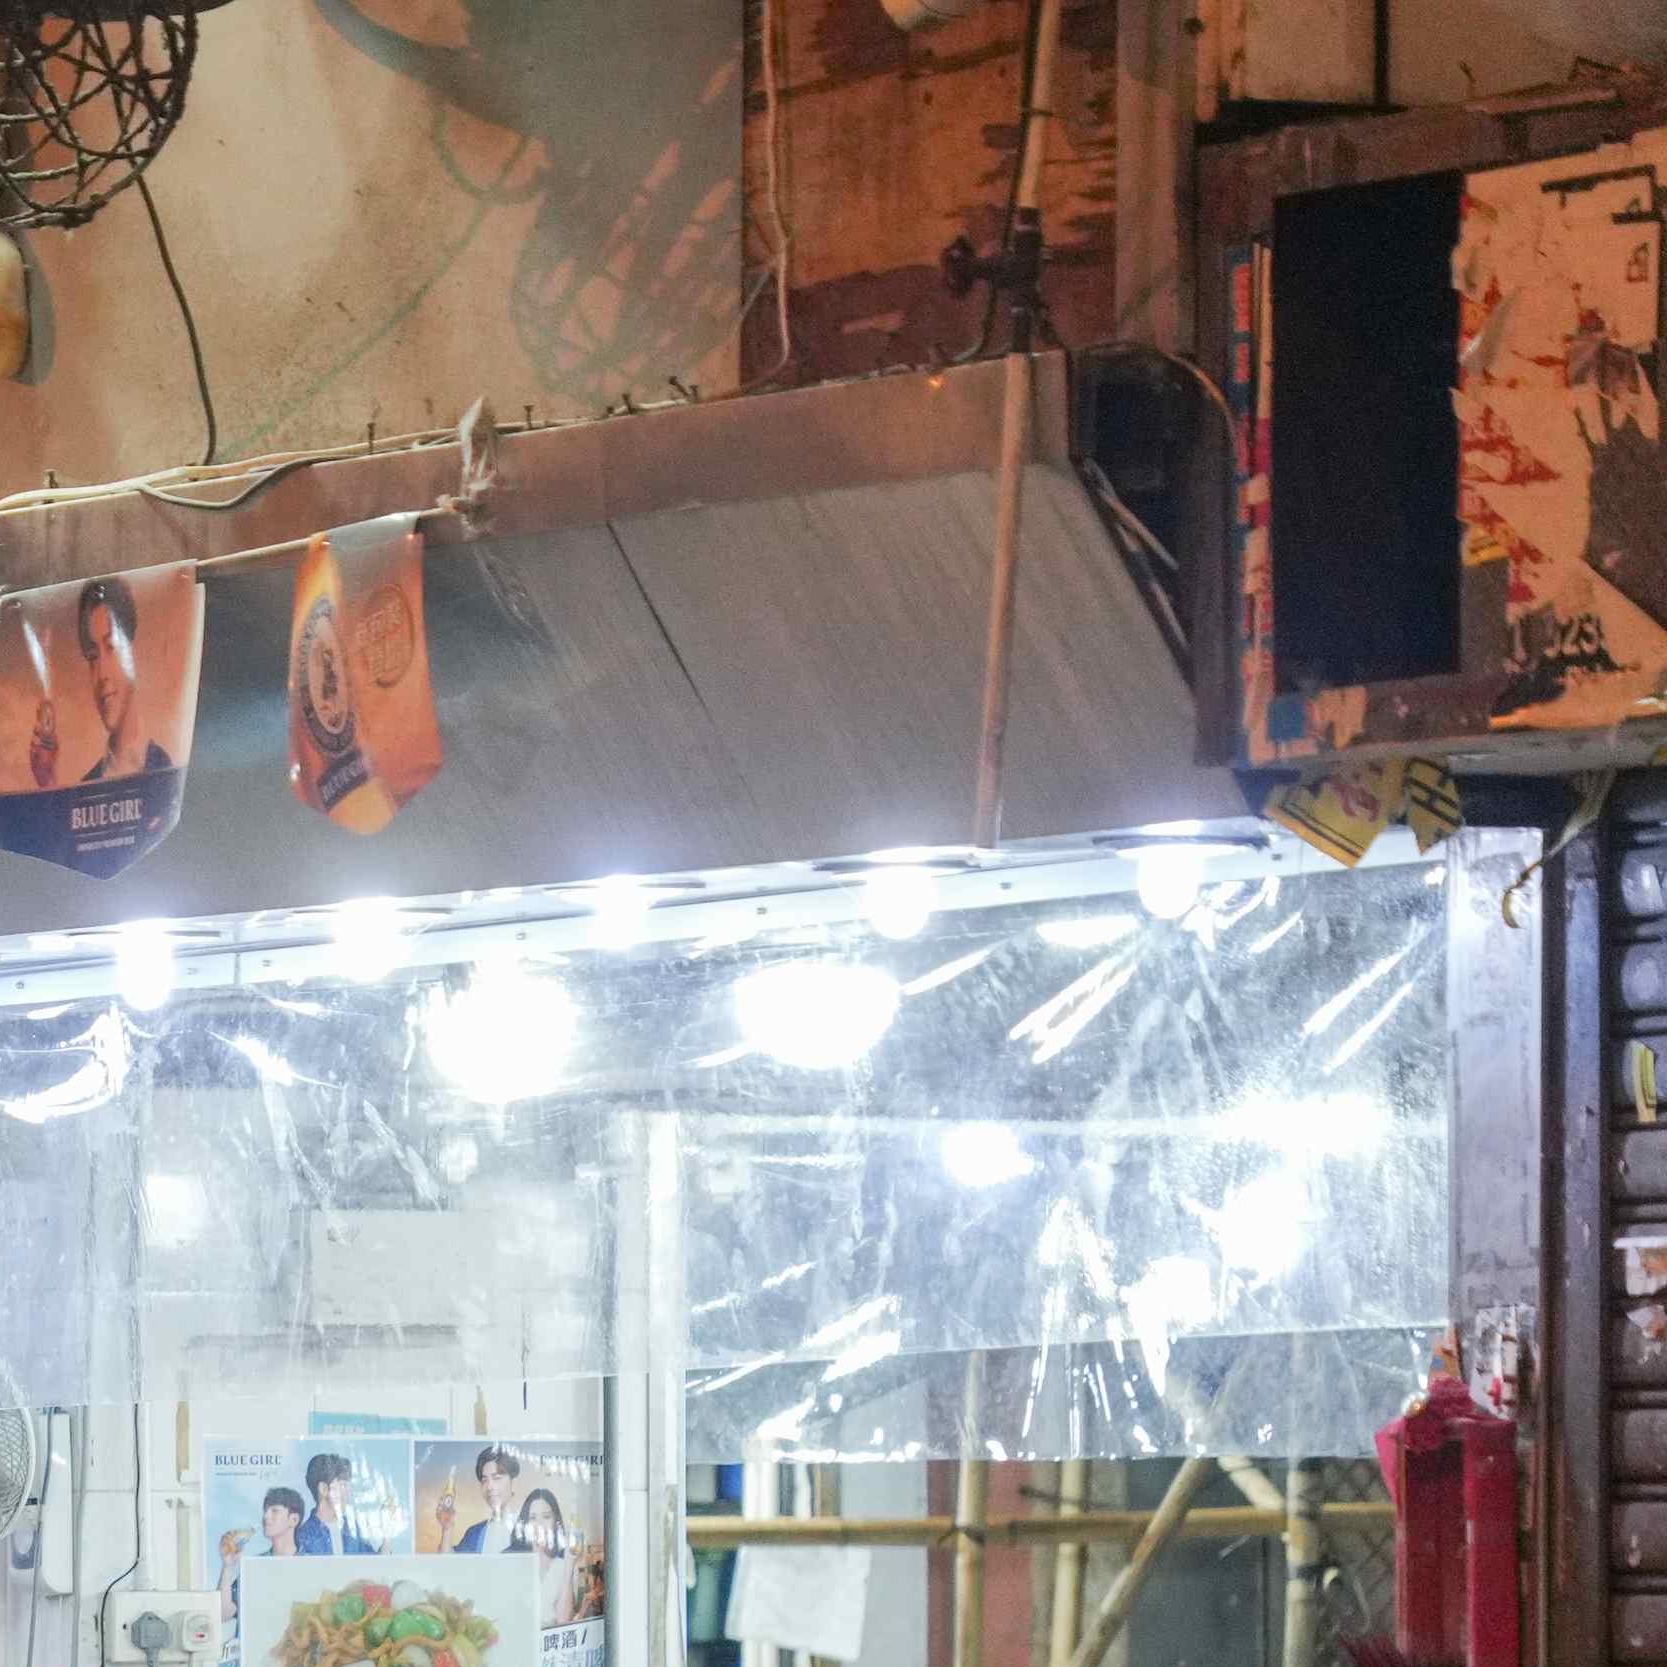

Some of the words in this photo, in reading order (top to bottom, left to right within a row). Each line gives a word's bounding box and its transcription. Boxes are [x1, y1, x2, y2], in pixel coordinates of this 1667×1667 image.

[71, 804, 108, 829] BLUE
[109, 799, 143, 823] GIRL
[215, 1454, 248, 1467] BLUE
[250, 1454, 282, 1466] GIRL
